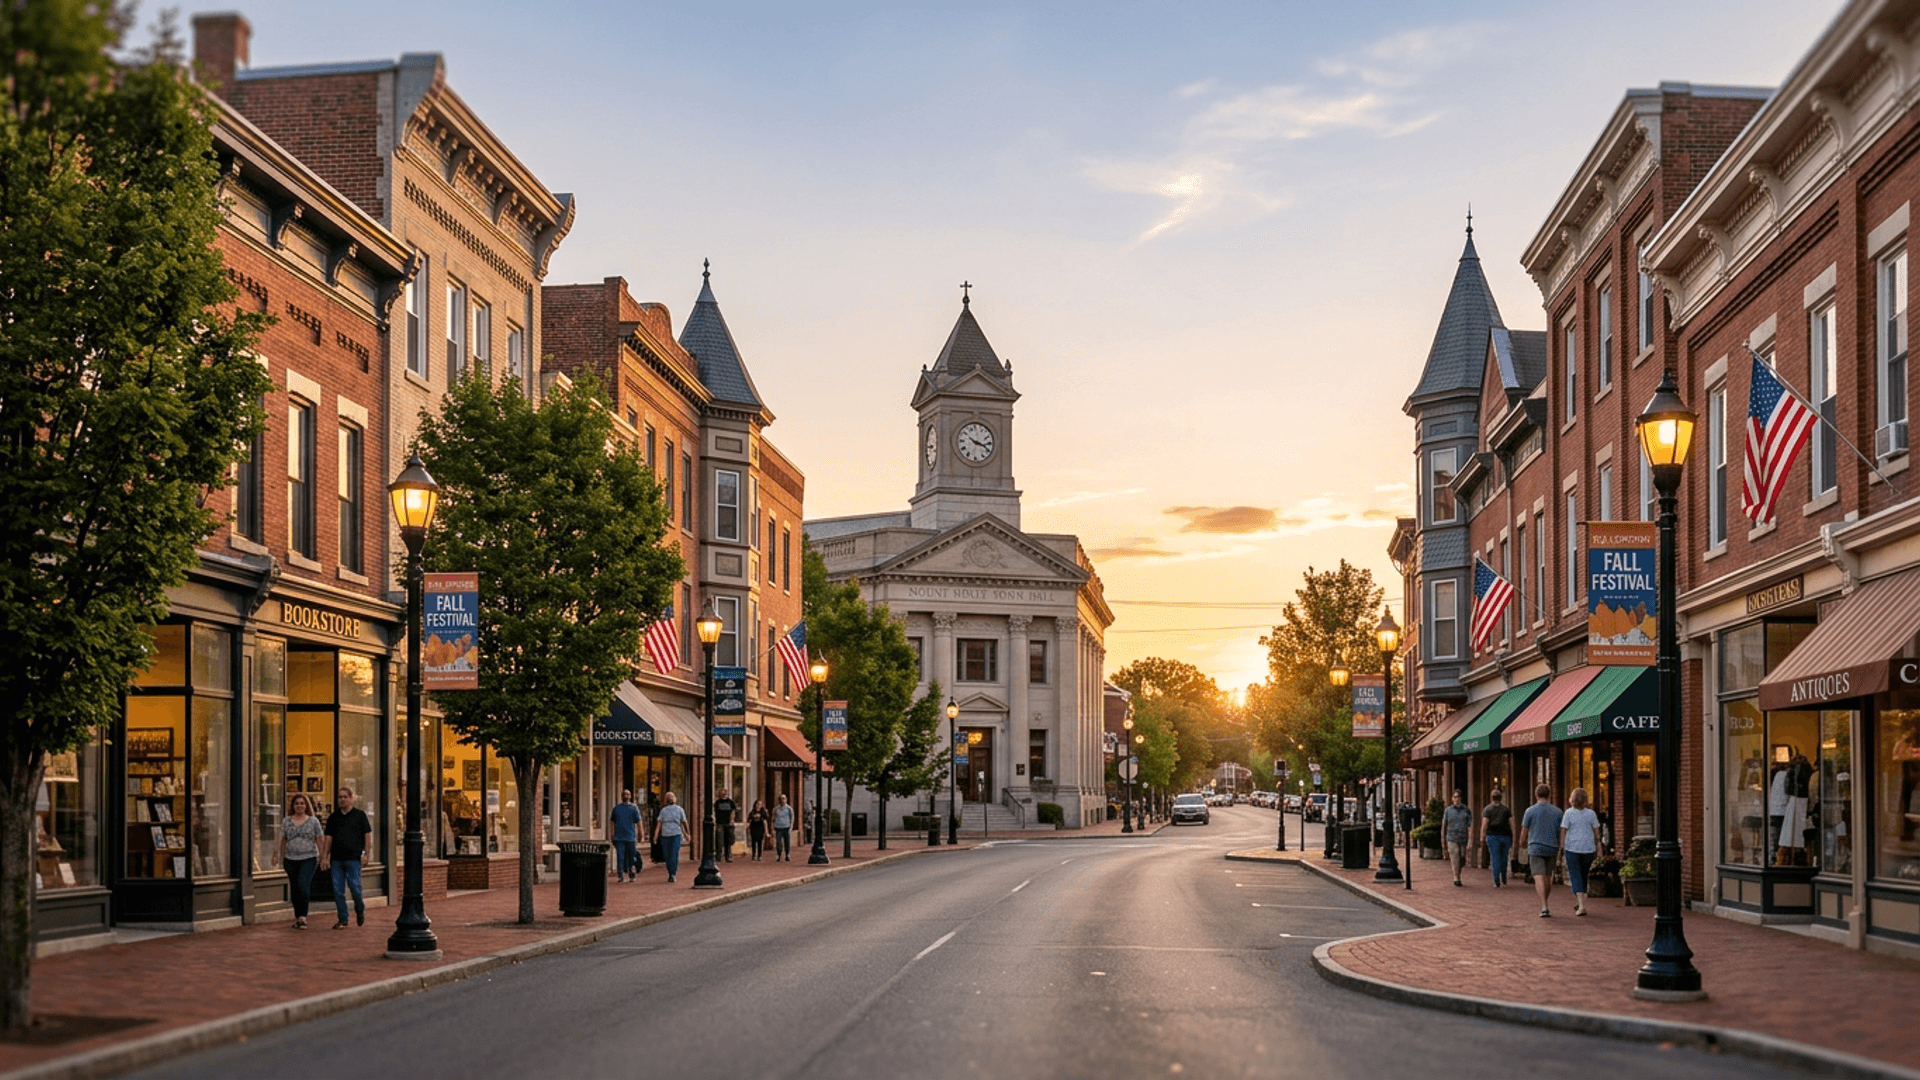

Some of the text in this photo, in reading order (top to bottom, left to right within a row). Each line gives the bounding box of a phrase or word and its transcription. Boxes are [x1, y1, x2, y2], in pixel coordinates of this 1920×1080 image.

[1603, 551, 1642, 571] FALL
[1592, 573, 1654, 590] FESTIVAL
[436, 594, 466, 612] FALL
[426, 612, 476, 627] FESTIVAL
[1612, 715, 1660, 730] CAFE
